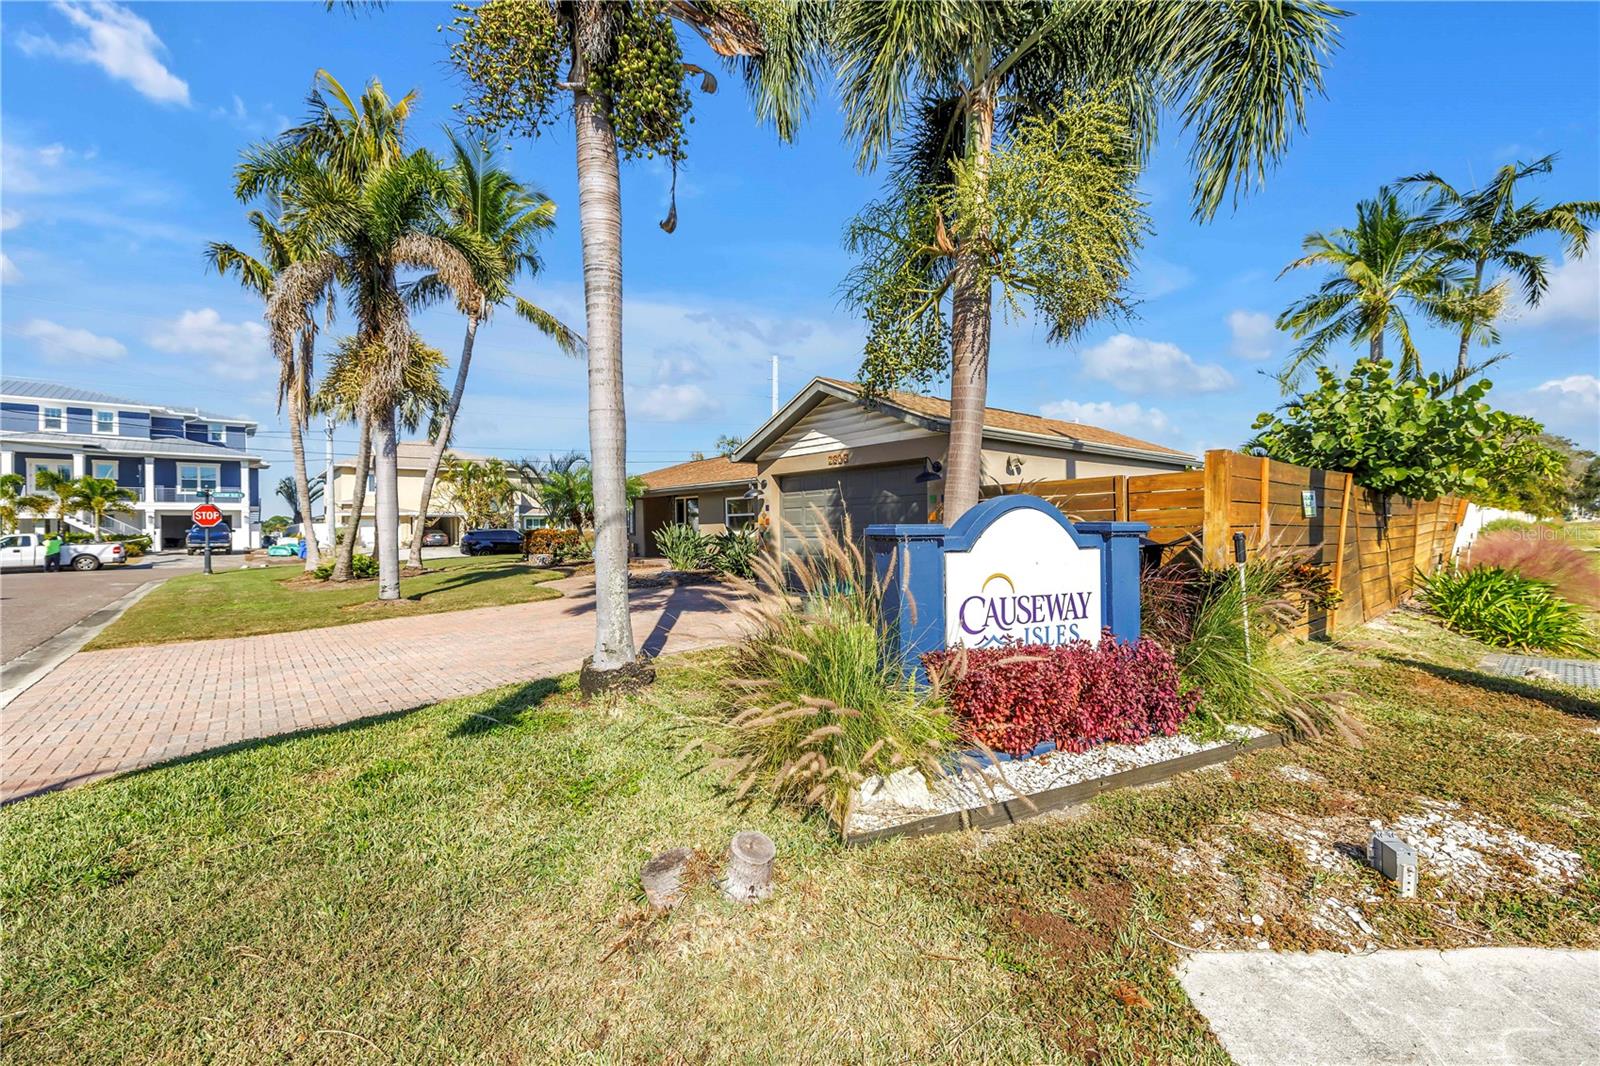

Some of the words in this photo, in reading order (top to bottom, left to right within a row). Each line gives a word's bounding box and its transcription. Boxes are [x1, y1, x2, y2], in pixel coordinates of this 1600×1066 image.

[195, 511, 220, 520] STOP
[959, 591, 1093, 635] CAUSEWAY
[1024, 623, 1080, 647] ISLES
